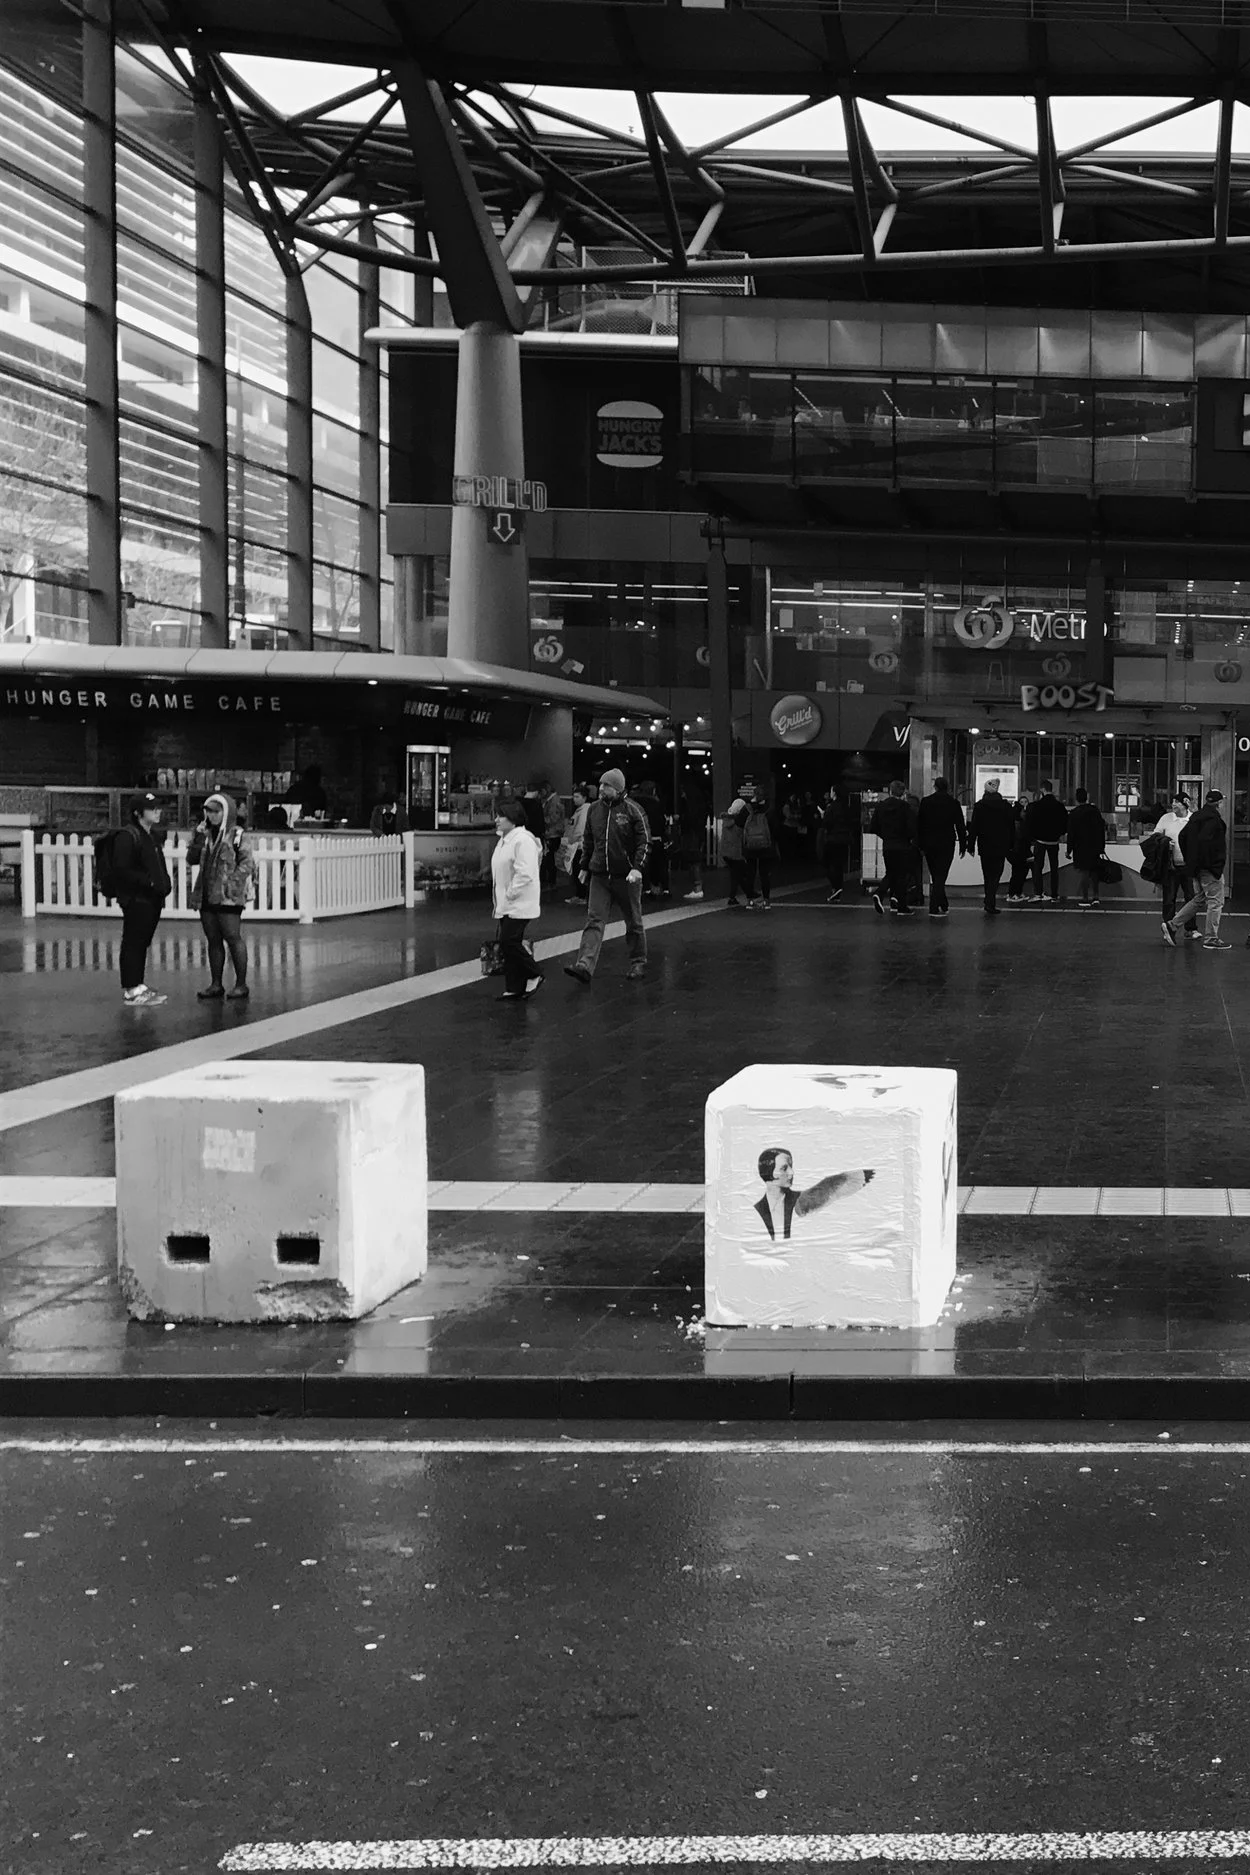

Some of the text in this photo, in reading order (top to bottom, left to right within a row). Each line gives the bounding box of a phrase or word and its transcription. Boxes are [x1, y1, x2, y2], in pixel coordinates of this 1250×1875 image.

[598, 419, 663, 433] HUNGRY
[1030, 613, 1107, 639] Metr
[6, 689, 281, 712] HUNGER GAME CAFE
[1021, 681, 1115, 712] BOOST
[403, 700, 440, 718] HUNGER
[470, 710, 492, 724] CAFE
